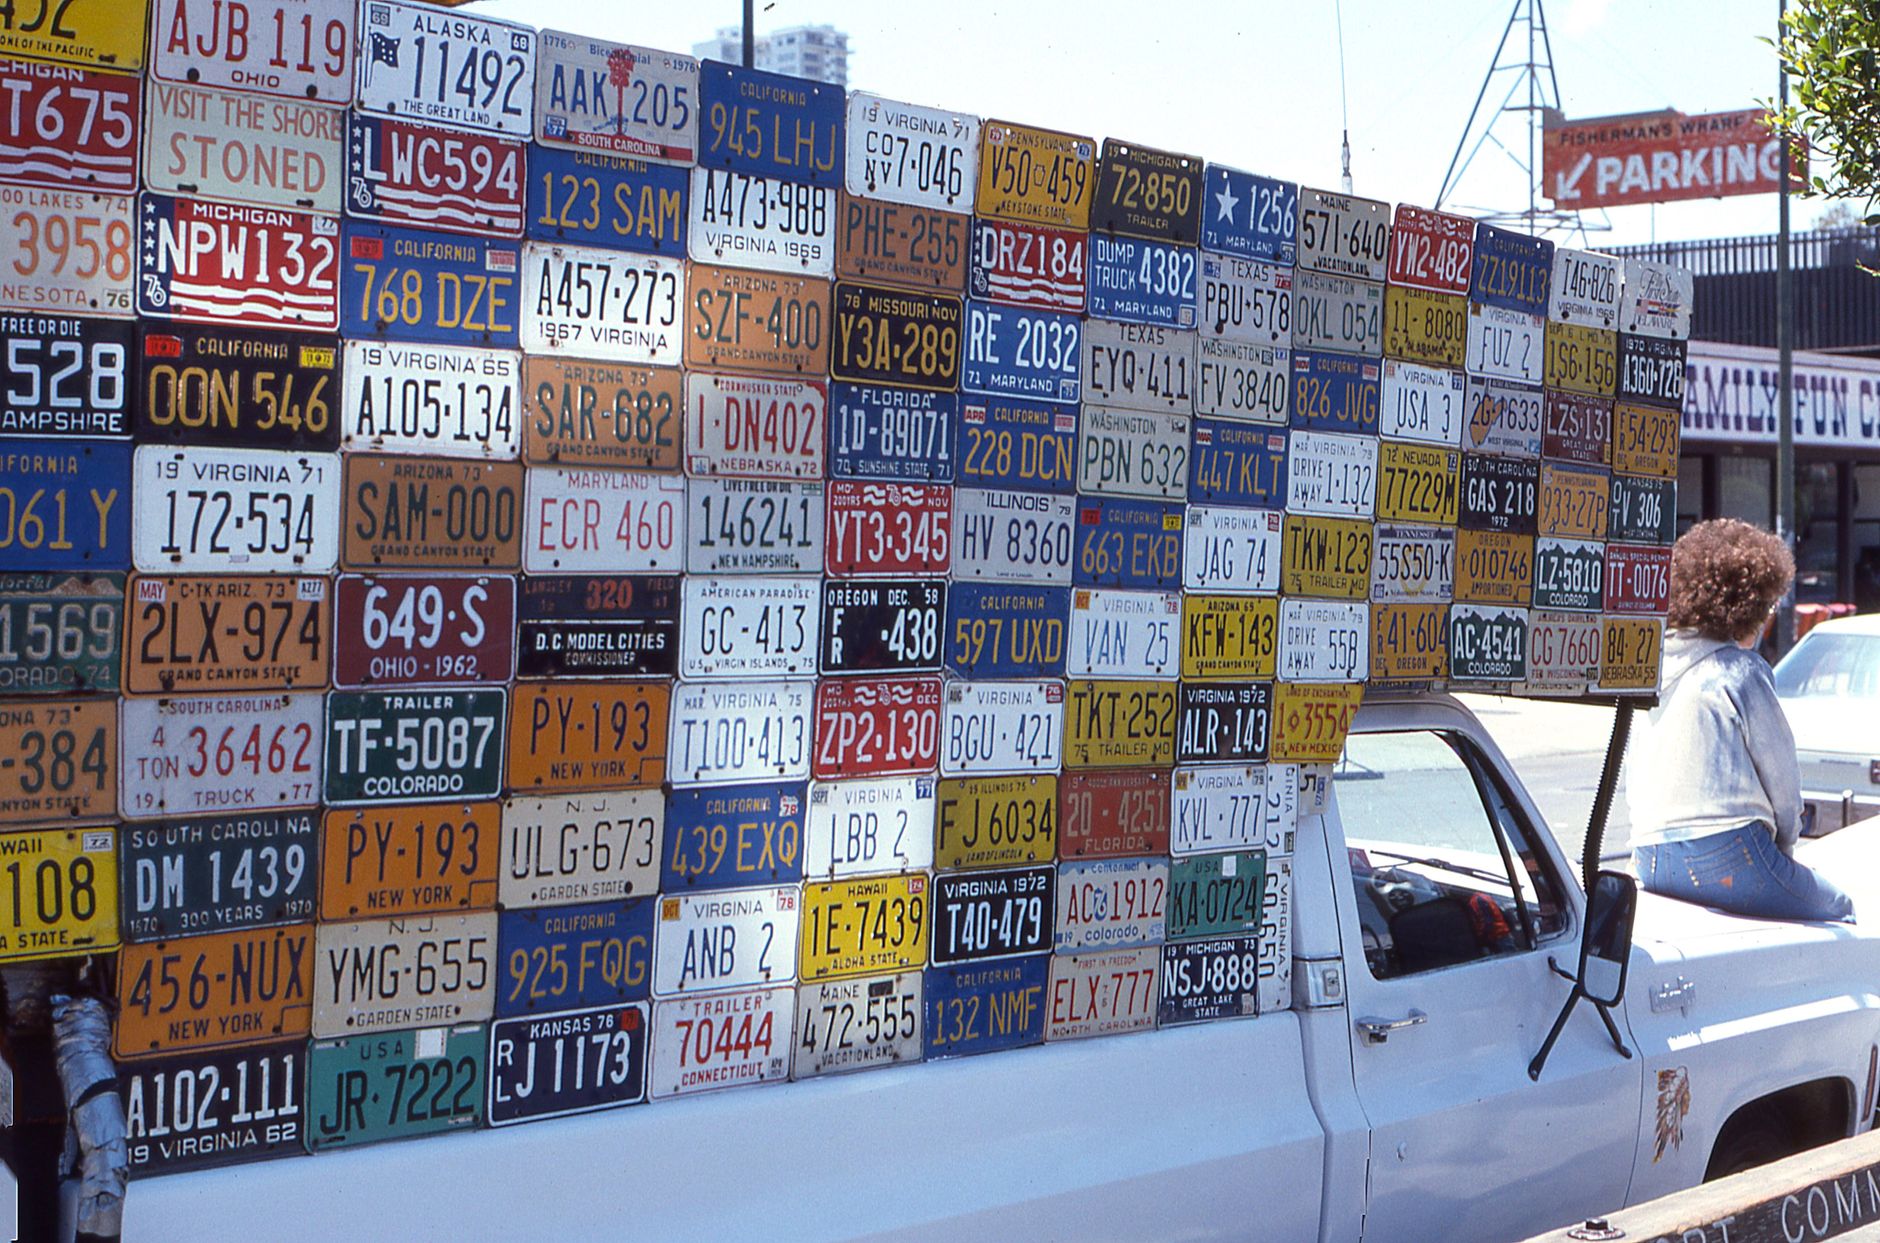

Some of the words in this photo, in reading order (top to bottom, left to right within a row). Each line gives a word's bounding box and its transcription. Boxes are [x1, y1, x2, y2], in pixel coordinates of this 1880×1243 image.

[168, 0, 250, 60] AJB
[269, 8, 346, 77] 119
[413, 15, 492, 46] ALASKA
[231, 70, 280, 88] OHIO
[413, 36, 526, 117] 11492
[551, 64, 608, 118] AAK
[632, 79, 689, 131] 205
[221, 94, 264, 131] THE
[403, 99, 424, 114] THE
[427, 103, 460, 120] GREAT
[463, 107, 490, 125] LAND
[885, 110, 948, 136] VIRGINIA
[710, 102, 762, 159] 945
[774, 114, 836, 171] LHJ
[1561, 125, 1672, 146] FISHERMAN'S
[1680, 115, 1745, 135] WHARF
[578, 133, 611, 150] SOUTH
[614, 138, 661, 156] CAROLINA
[168, 132, 326, 194] STONED
[193, 203, 293, 227] MICHIGAN
[538, 172, 601, 231] 123
[612, 183, 680, 242] SAM
[1250, 185, 1295, 238] 1256
[1321, 197, 1351, 212] MAINE
[12, 211, 132, 282] 3958
[395, 240, 477, 264] CALIFORNIA
[706, 232, 777, 255] VIRGINIA
[1226, 235, 1273, 254] MARYLAND
[1139, 248, 1194, 299] 4382
[1230, 261, 1269, 281] TEXAS
[354, 264, 423, 325] 768
[437, 272, 513, 332] DZE
[39, 319, 58, 335] OR
[60, 320, 82, 337] DIE
[695, 288, 821, 349] SZF-400
[1343, 303, 1378, 344] 054
[197, 338, 288, 359] CALIFORNIA
[590, 326, 667, 349] VIRGINIA
[969, 310, 1001, 363] RE
[1015, 317, 1078, 373] 2032
[1481, 327, 1512, 371] FUZ
[390, 351, 476, 373] VIRGINIA
[990, 374, 1053, 391] MARYLAND
[1201, 364, 1227, 407] FV
[1232, 368, 1286, 414] 3840
[253, 372, 329, 433] 546
[861, 390, 931, 409] FLORIDA
[1297, 377, 1331, 418] 826
[1337, 383, 1376, 424] JVG
[1398, 388, 1428, 431] USA
[1442, 394, 1450, 434] 3
[1684, 365, 1779, 433] AMILY
[1795, 374, 1848, 437] FUN
[536, 382, 674, 447] SAR-682
[721, 459, 792, 472] NEBRASKA
[965, 428, 1012, 476] 228
[1020, 433, 1073, 481] DCN
[1085, 435, 1131, 484] PBN
[1141, 443, 1185, 488] 632
[1403, 452, 1441, 466] NEVADA
[193, 463, 291, 483] VIRGINIA
[394, 464, 453, 480] ARIZONA
[568, 471, 649, 489] MARYLAND
[1294, 458, 1323, 478] DRIVE
[987, 492, 1049, 511] ILLINOIS
[1294, 483, 1322, 502] AWAY
[1468, 478, 1496, 512] GAS
[1505, 480, 1535, 514] 218
[356, 481, 516, 542] SAM-000
[700, 495, 812, 548] 146241
[1214, 515, 1258, 530] VIRGINIA
[539, 498, 601, 551] ECR
[616, 500, 674, 551] 460
[963, 514, 994, 560] HV
[1007, 518, 1070, 566] 8360
[1082, 530, 1124, 574] 663
[1131, 533, 1179, 577] EKB
[1197, 536, 1234, 581] JAG
[1310, 575, 1347, 589] TRAILER
[828, 590, 878, 606] OREGON
[1550, 592, 1589, 606] COLORADO
[141, 601, 321, 665] 2LX-974
[568, 633, 615, 650] MODEL
[619, 633, 665, 650] CITIES
[956, 618, 1002, 665] 597
[1011, 618, 1063, 664] UXD
[1085, 619, 1128, 665] VAN
[1288, 627, 1316, 645] DRIVE
[1559, 628, 1599, 666] 7660
[370, 657, 417, 678] OHIO
[1288, 652, 1315, 670] AWAY
[1468, 663, 1512, 675] COLORADO
[215, 668, 257, 681] CANYON
[263, 667, 301, 679] STATE
[384, 697, 453, 710] TRAILER
[712, 694, 778, 708] VIRGINIA
[1187, 690, 1235, 703] VIRGINIA
[1240, 690, 1265, 703] 1972
[531, 697, 650, 756] PY-193
[188, 722, 312, 777] 36462
[138, 758, 179, 780] TON
[552, 762, 583, 779] NEW
[592, 758, 627, 777] YORK
[364, 774, 463, 796] COLORADO
[1198, 775, 1243, 789] VIRGINIA
[194, 788, 255, 806] TRUCK
[845, 789, 903, 805] VIRGINIA
[990, 798, 1052, 845] 6034
[672, 825, 728, 876] 439
[737, 821, 798, 871] EXQ
[832, 813, 878, 865] LBB
[893, 810, 907, 857] 2
[346, 820, 480, 885] PY-193
[136, 854, 184, 913] DM
[209, 844, 306, 903] 1439
[540, 884, 588, 900] GARDEN
[593, 881, 625, 896] STATE
[945, 880, 1007, 898] VIRGINIA
[368, 891, 403, 909] NEW
[413, 885, 453, 905] YORK
[693, 900, 764, 918] VIRGINIA
[216, 906, 264, 923] YEARS
[545, 913, 615, 934] CALIFORNIA
[1278, 883, 1287, 966] VIRGINIA
[18, 930, 68, 948] STATE
[682, 924, 736, 980] ANB
[758, 922, 774, 973] 2
[1186, 941, 1235, 955] MICHIGAN
[509, 943, 568, 1004] 925
[578, 936, 648, 993] FQG
[870, 953, 898, 965] STATE
[129, 936, 307, 1017] 456-NUX
[694, 996, 762, 1016] TRAILER
[1052, 975, 1100, 1024] ELX
[1111, 969, 1154, 1017] 777
[1183, 998, 1208, 1008] GREAT
[1214, 994, 1233, 1005] LAKE
[357, 1010, 410, 1027] GARDEN
[415, 1005, 451, 1021] STATE
[933, 996, 979, 1046] 132
[989, 985, 1042, 1036] NMF
[1195, 1007, 1220, 1017] STATE
[169, 1020, 210, 1042] NEW
[220, 1012, 264, 1035] YORK
[531, 1018, 591, 1039] KANSAS
[676, 1011, 773, 1067] 70444
[682, 1062, 763, 1085] CONNECTICUT
[160, 1130, 258, 1160] VIRGINIA
